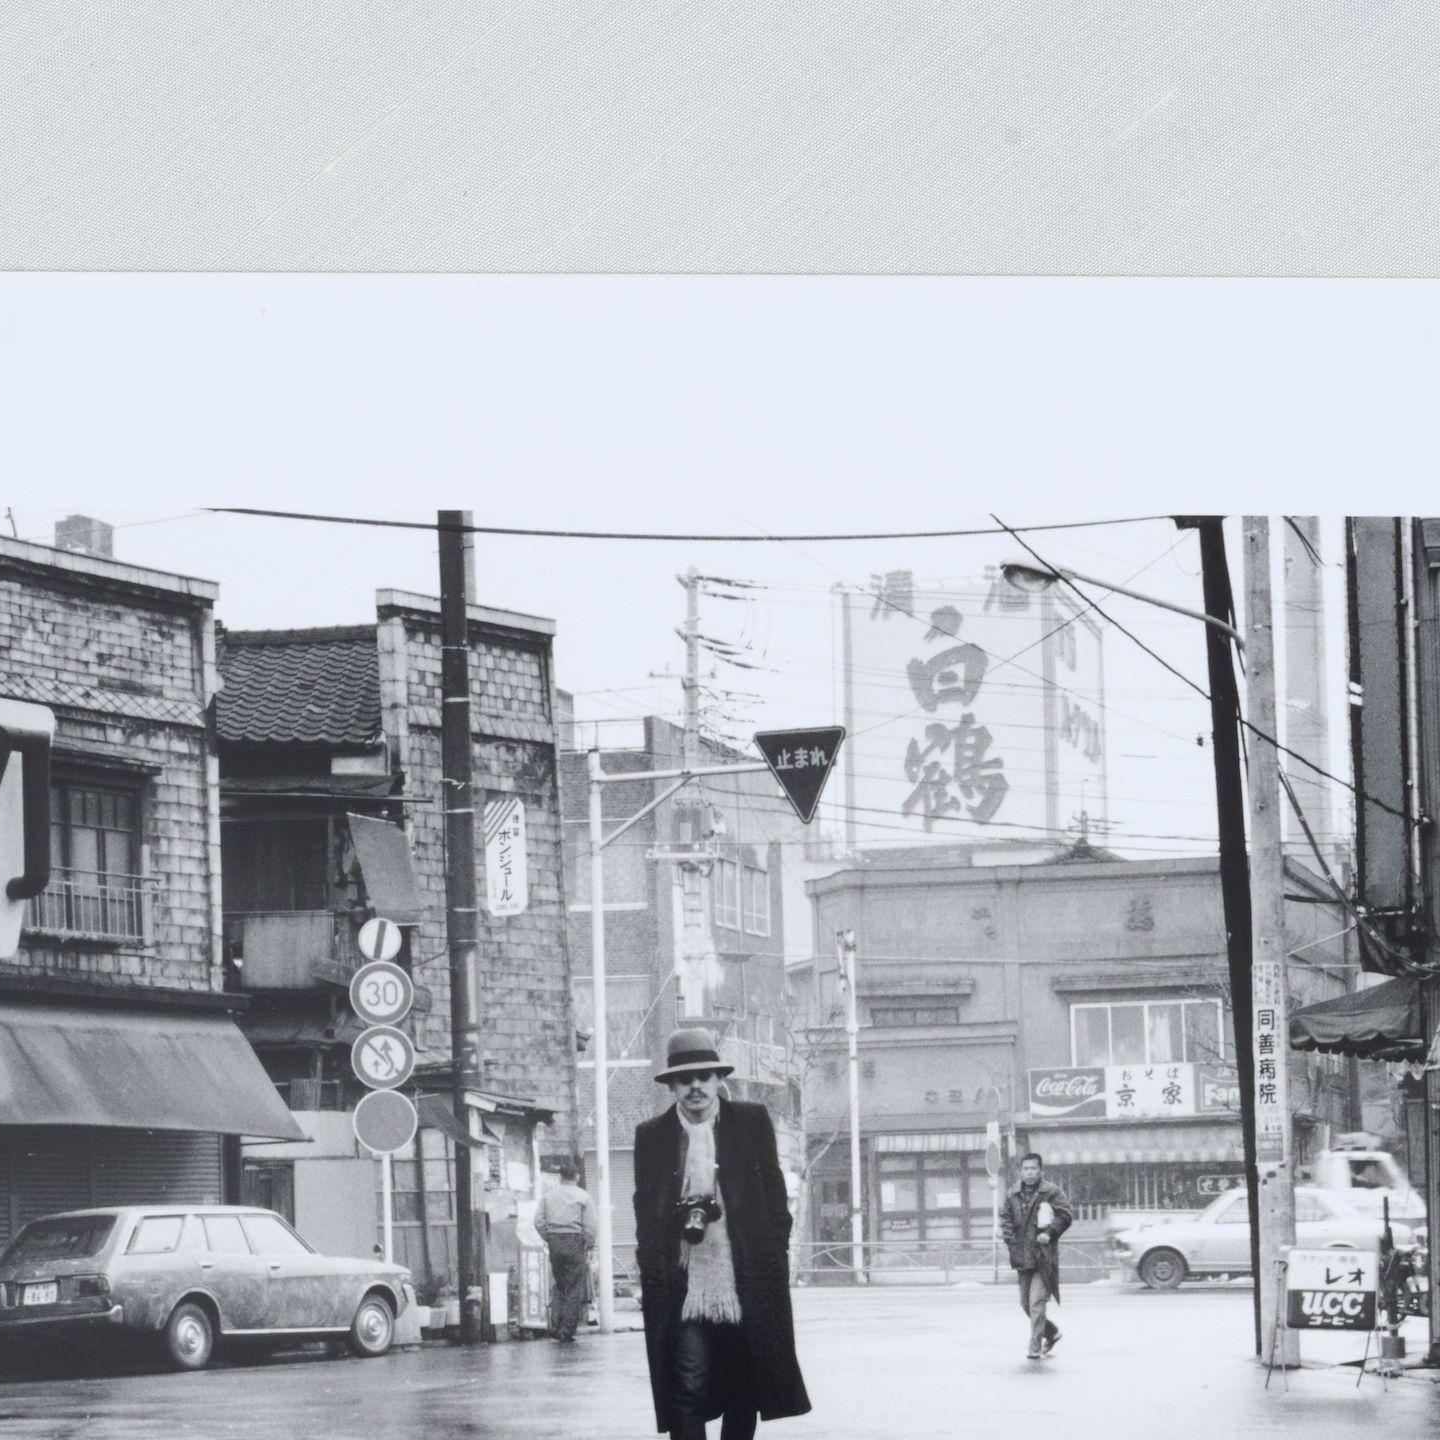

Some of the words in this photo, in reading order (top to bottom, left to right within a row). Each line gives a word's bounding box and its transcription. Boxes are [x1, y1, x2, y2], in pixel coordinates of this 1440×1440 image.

[776, 746, 829, 770] 止まれ
[366, 980, 399, 1007] 30
[1258, 1009, 1278, 1105] 同善病院
[1116, 1082, 1182, 1107] 京家
[1325, 1266, 1366, 1287] レオ
[1308, 1315, 1355, 1326] コーヒー
